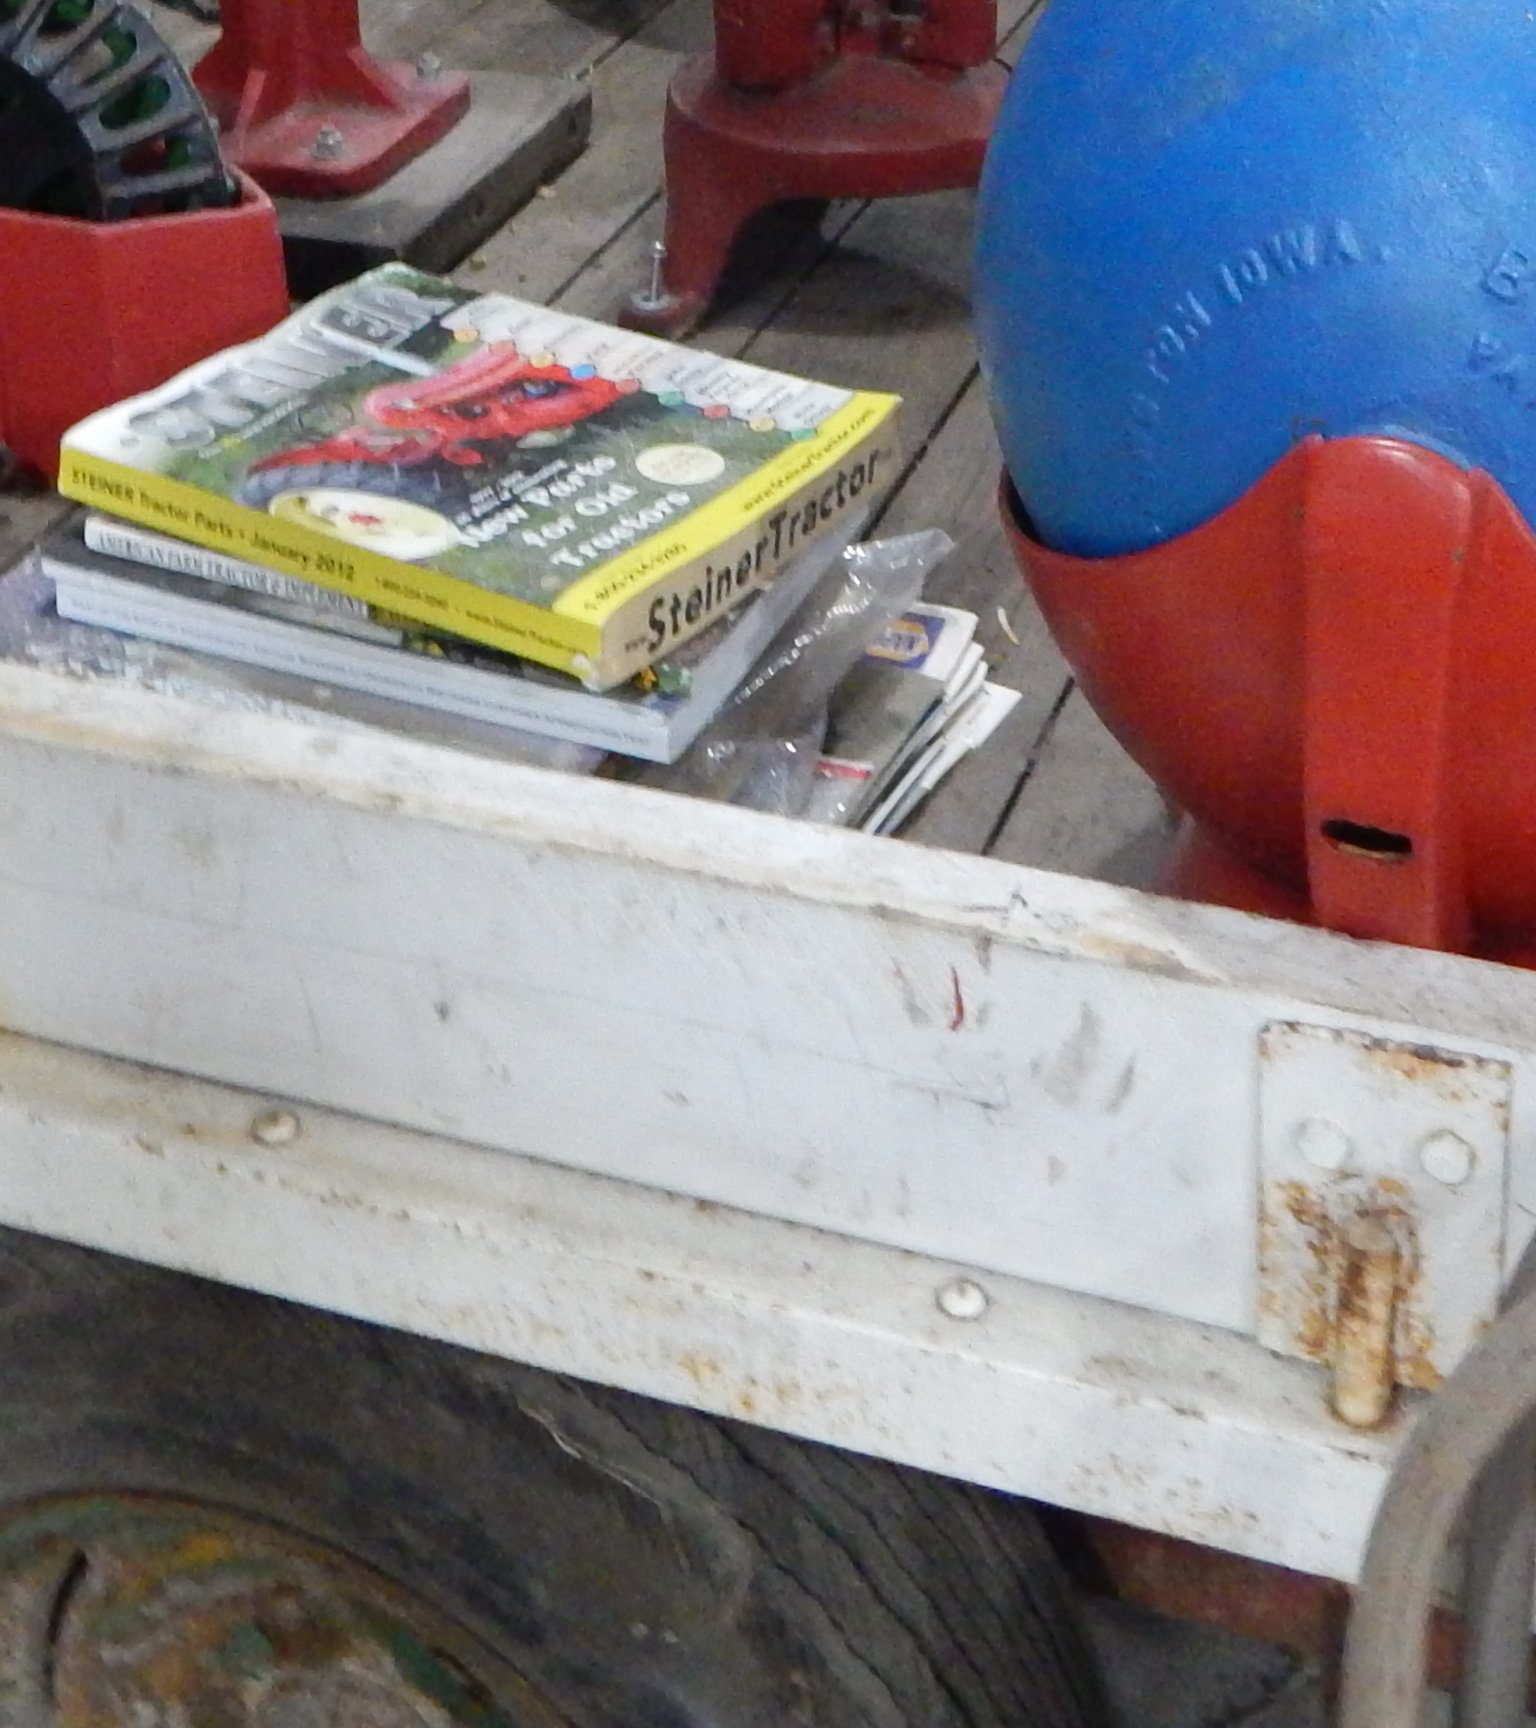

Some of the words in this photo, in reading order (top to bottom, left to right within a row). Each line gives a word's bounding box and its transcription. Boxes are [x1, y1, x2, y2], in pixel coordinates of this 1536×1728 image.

[72, 468, 133, 502] STEINER
[522, 514, 576, 547] for
[575, 481, 638, 516] Old
[549, 490, 690, 567] Tractors
